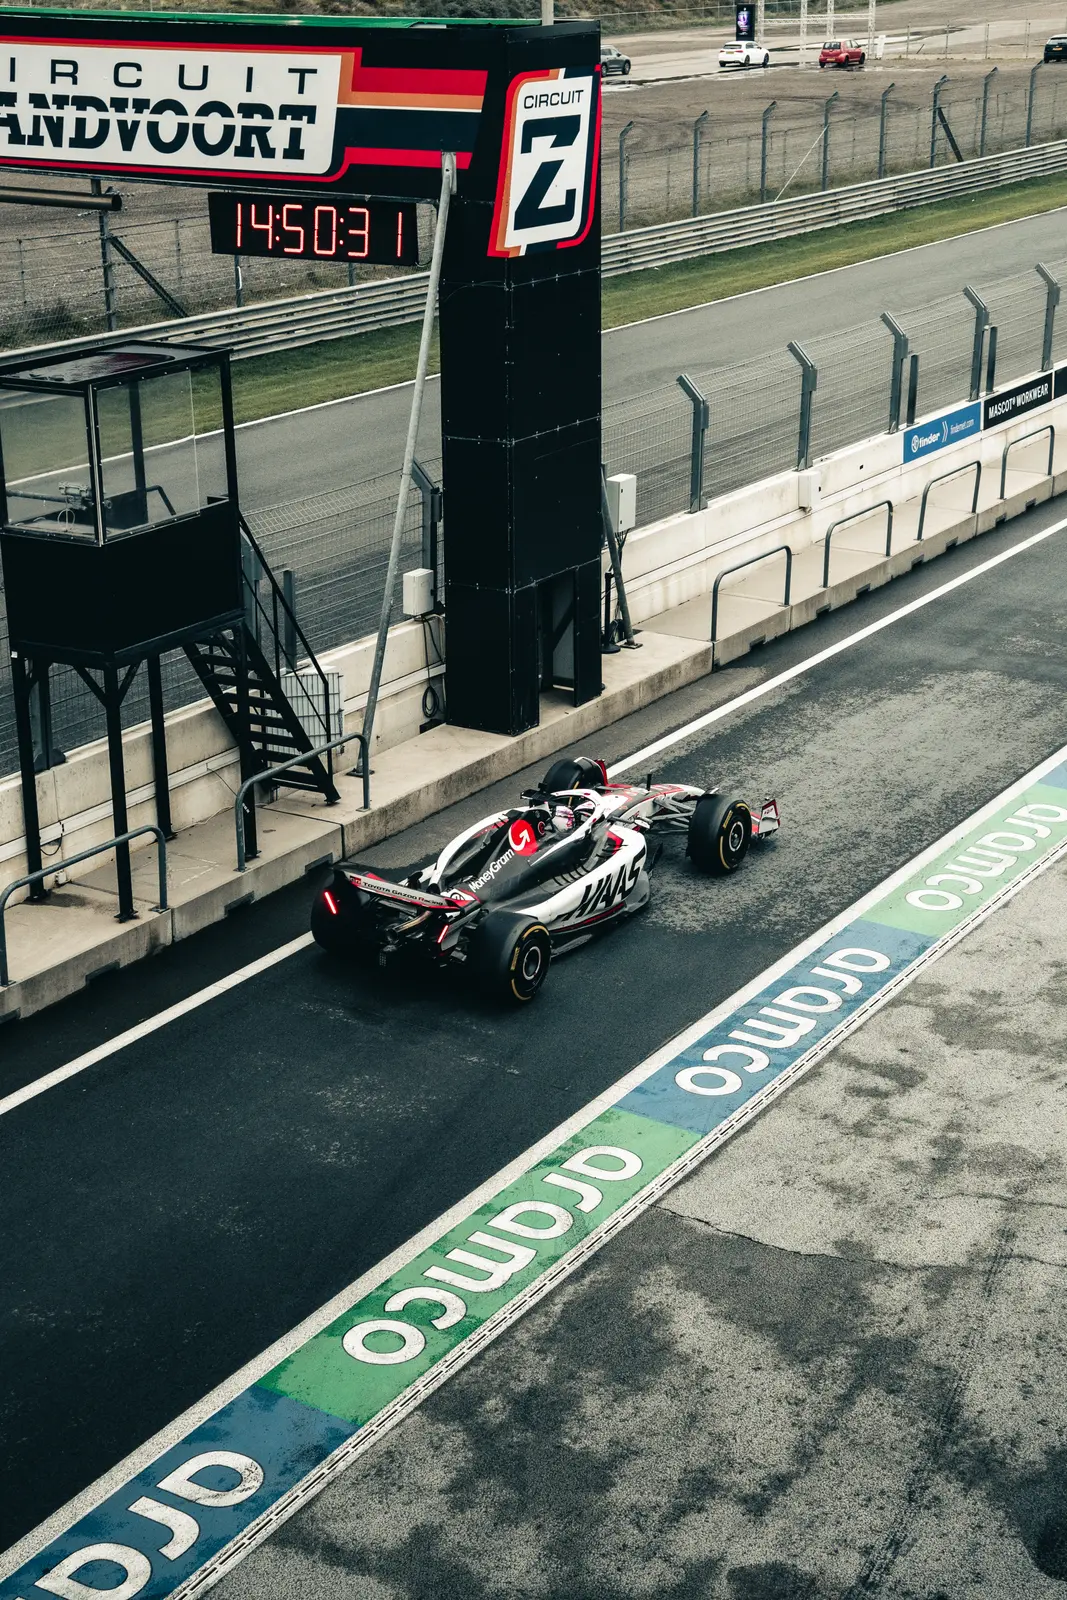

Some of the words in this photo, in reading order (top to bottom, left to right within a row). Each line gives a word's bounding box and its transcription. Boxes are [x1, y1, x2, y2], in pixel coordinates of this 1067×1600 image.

[9, 57, 318, 95] IRCUIT
[523, 89, 584, 110] CIRCUIT
[0, 91, 317, 161] ANDVOORT
[513, 114, 581, 231] Z
[1016, 383, 1049, 408] WORKWEAR
[919, 431, 941, 449] finder
[950, 418, 975, 435] findernet.com
[468, 848, 515, 894] MoneyGram
[558, 846, 646, 922] HAAS
[905, 803, 1067, 911] aramco
[362, 881, 391, 893] TOYOTA
[418, 896, 444, 906] Racing
[674, 947, 891, 1096] aramco
[341, 1145, 643, 1366] aramco
[14, 1450, 265, 1600] ara
